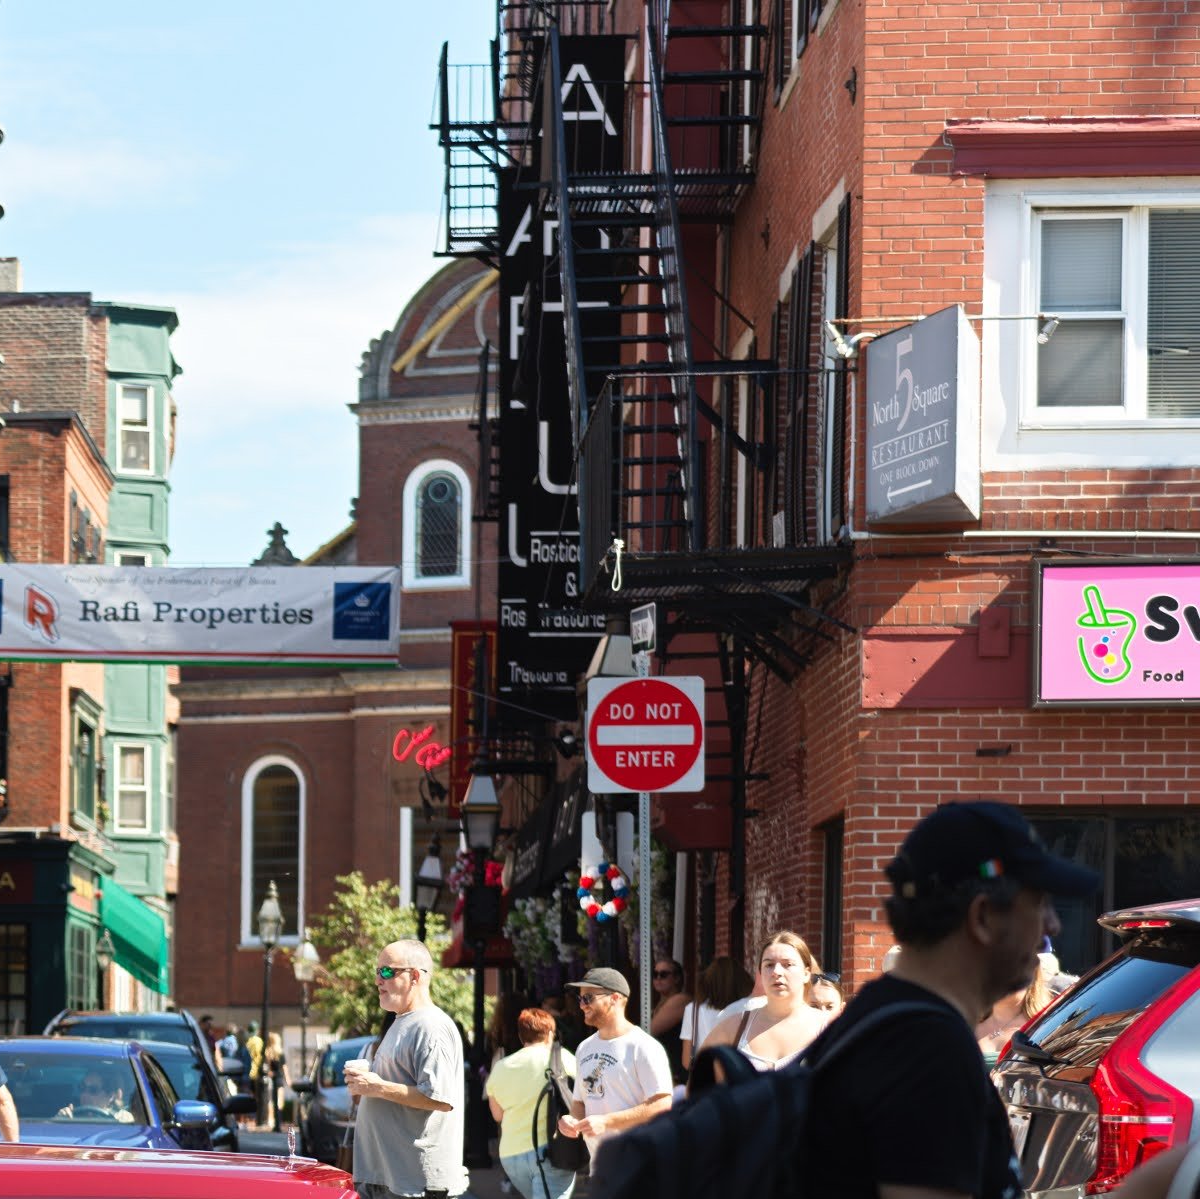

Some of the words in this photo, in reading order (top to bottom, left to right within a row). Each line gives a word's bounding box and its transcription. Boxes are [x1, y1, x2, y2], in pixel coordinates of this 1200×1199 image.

[872, 393, 900, 427] North
[911, 381, 950, 417] Square
[871, 422, 949, 467] RESTAURANT
[879, 470, 893, 486] ONE
[895, 463, 917, 482] BLOCK
[918, 455, 940, 474] DOWN
[530, 538, 581, 564] Rostic
[565, 571, 578, 597] &
[79, 600, 141, 622] Rafi
[152, 602, 314, 629] Properties
[1142, 670, 1184, 682] Food
[610, 703, 634, 720] DO
[646, 703, 682, 720] NOT
[615, 751, 675, 768] ENTER
